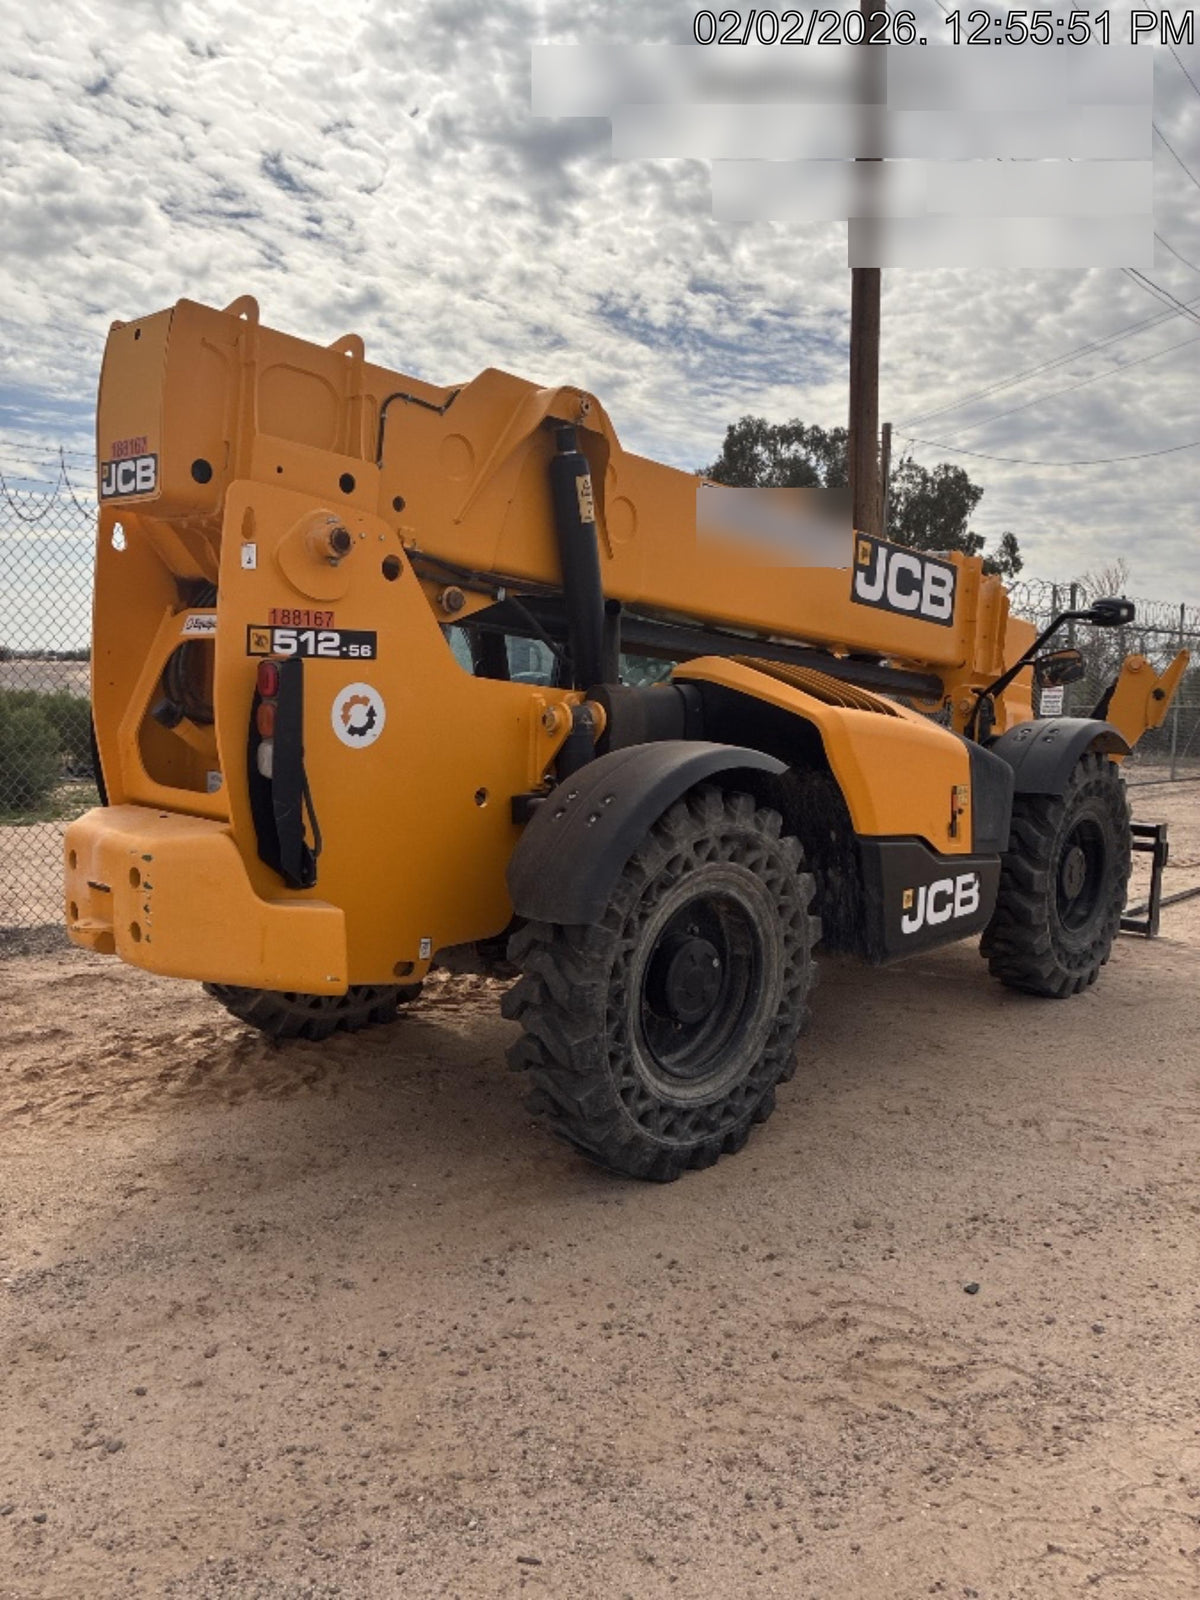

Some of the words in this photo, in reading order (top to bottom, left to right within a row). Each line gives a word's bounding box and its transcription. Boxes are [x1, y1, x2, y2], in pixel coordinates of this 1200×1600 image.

[102, 457, 155, 495] JCB
[855, 546, 954, 619] JCB
[269, 608, 334, 627] 188167
[901, 872, 980, 934] JCB
